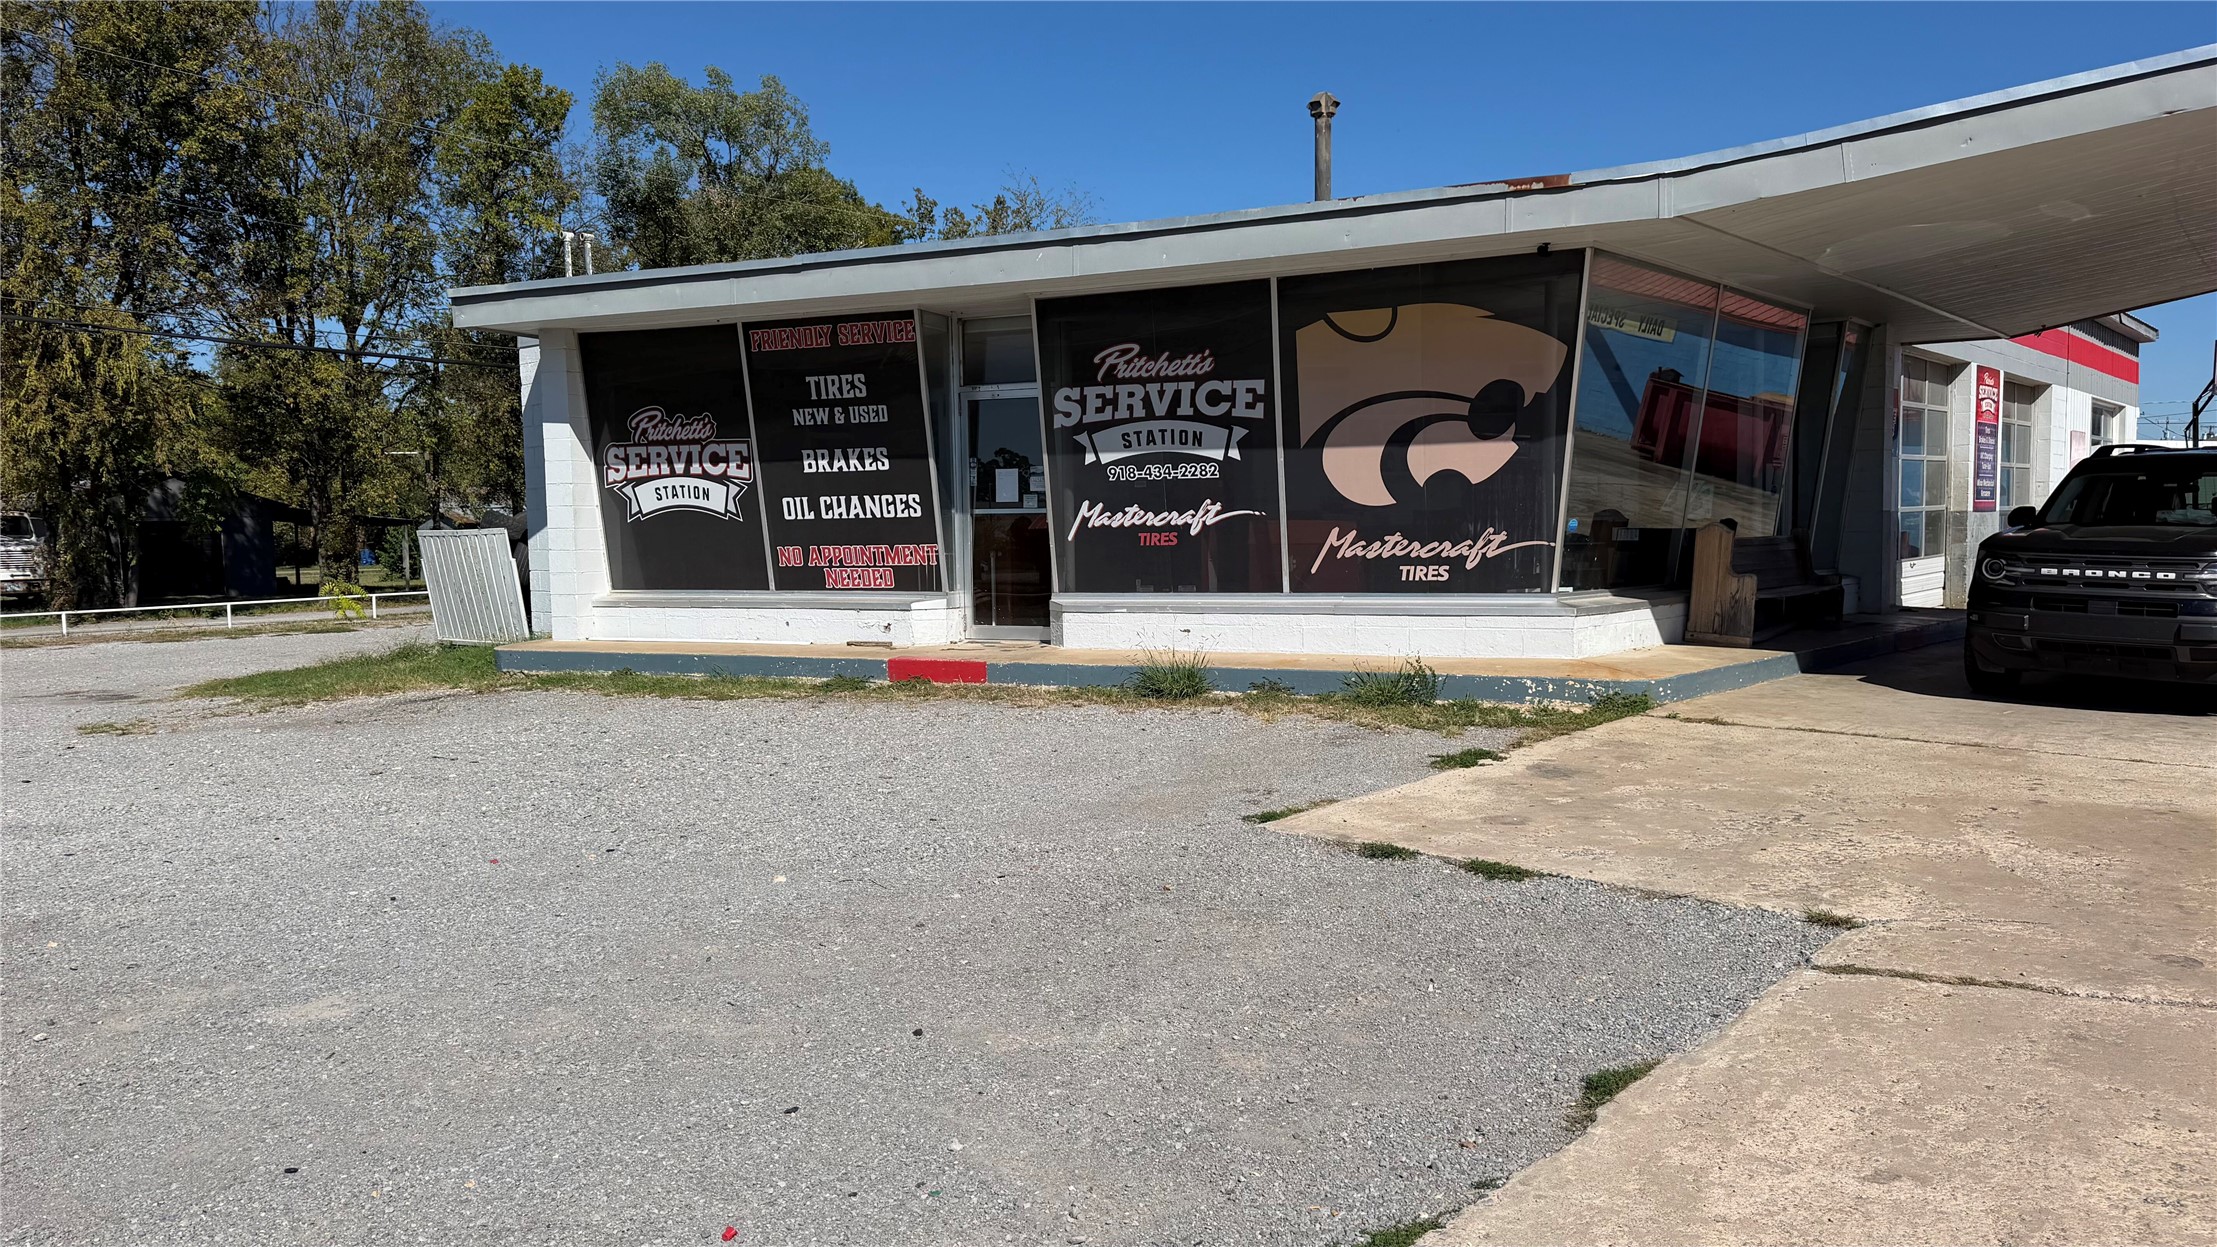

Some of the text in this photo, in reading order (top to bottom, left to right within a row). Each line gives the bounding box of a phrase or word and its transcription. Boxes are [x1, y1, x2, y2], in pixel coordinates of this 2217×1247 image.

[749, 319, 916, 352] FRIENDLY SERVICE
[1093, 343, 1215, 383] Pritchett's
[805, 373, 867, 400] TIRES
[793, 405, 889, 427] NEW & USED
[1053, 379, 1265, 429] SERVICE
[629, 407, 715, 444] Pritchett's
[1121, 428, 1204, 449] STATION
[604, 441, 753, 485] SERVICE
[801, 447, 890, 473] BRAKES
[1107, 462, 1220, 481] 918-434-2282
[654, 485, 711, 502] STATION
[781, 493, 922, 521] OIL CHANGES
[1067, 498, 1267, 541] Mastercraft
[1138, 531, 1178, 547] TIRES
[1311, 526, 1556, 575] Mastercraft
[776, 543, 938, 567] NO APPOINTMENT
[824, 567, 895, 589] NEEDED
[1399, 564, 1450, 582] TIRES
[2040, 567, 2176, 580] BRONCO
